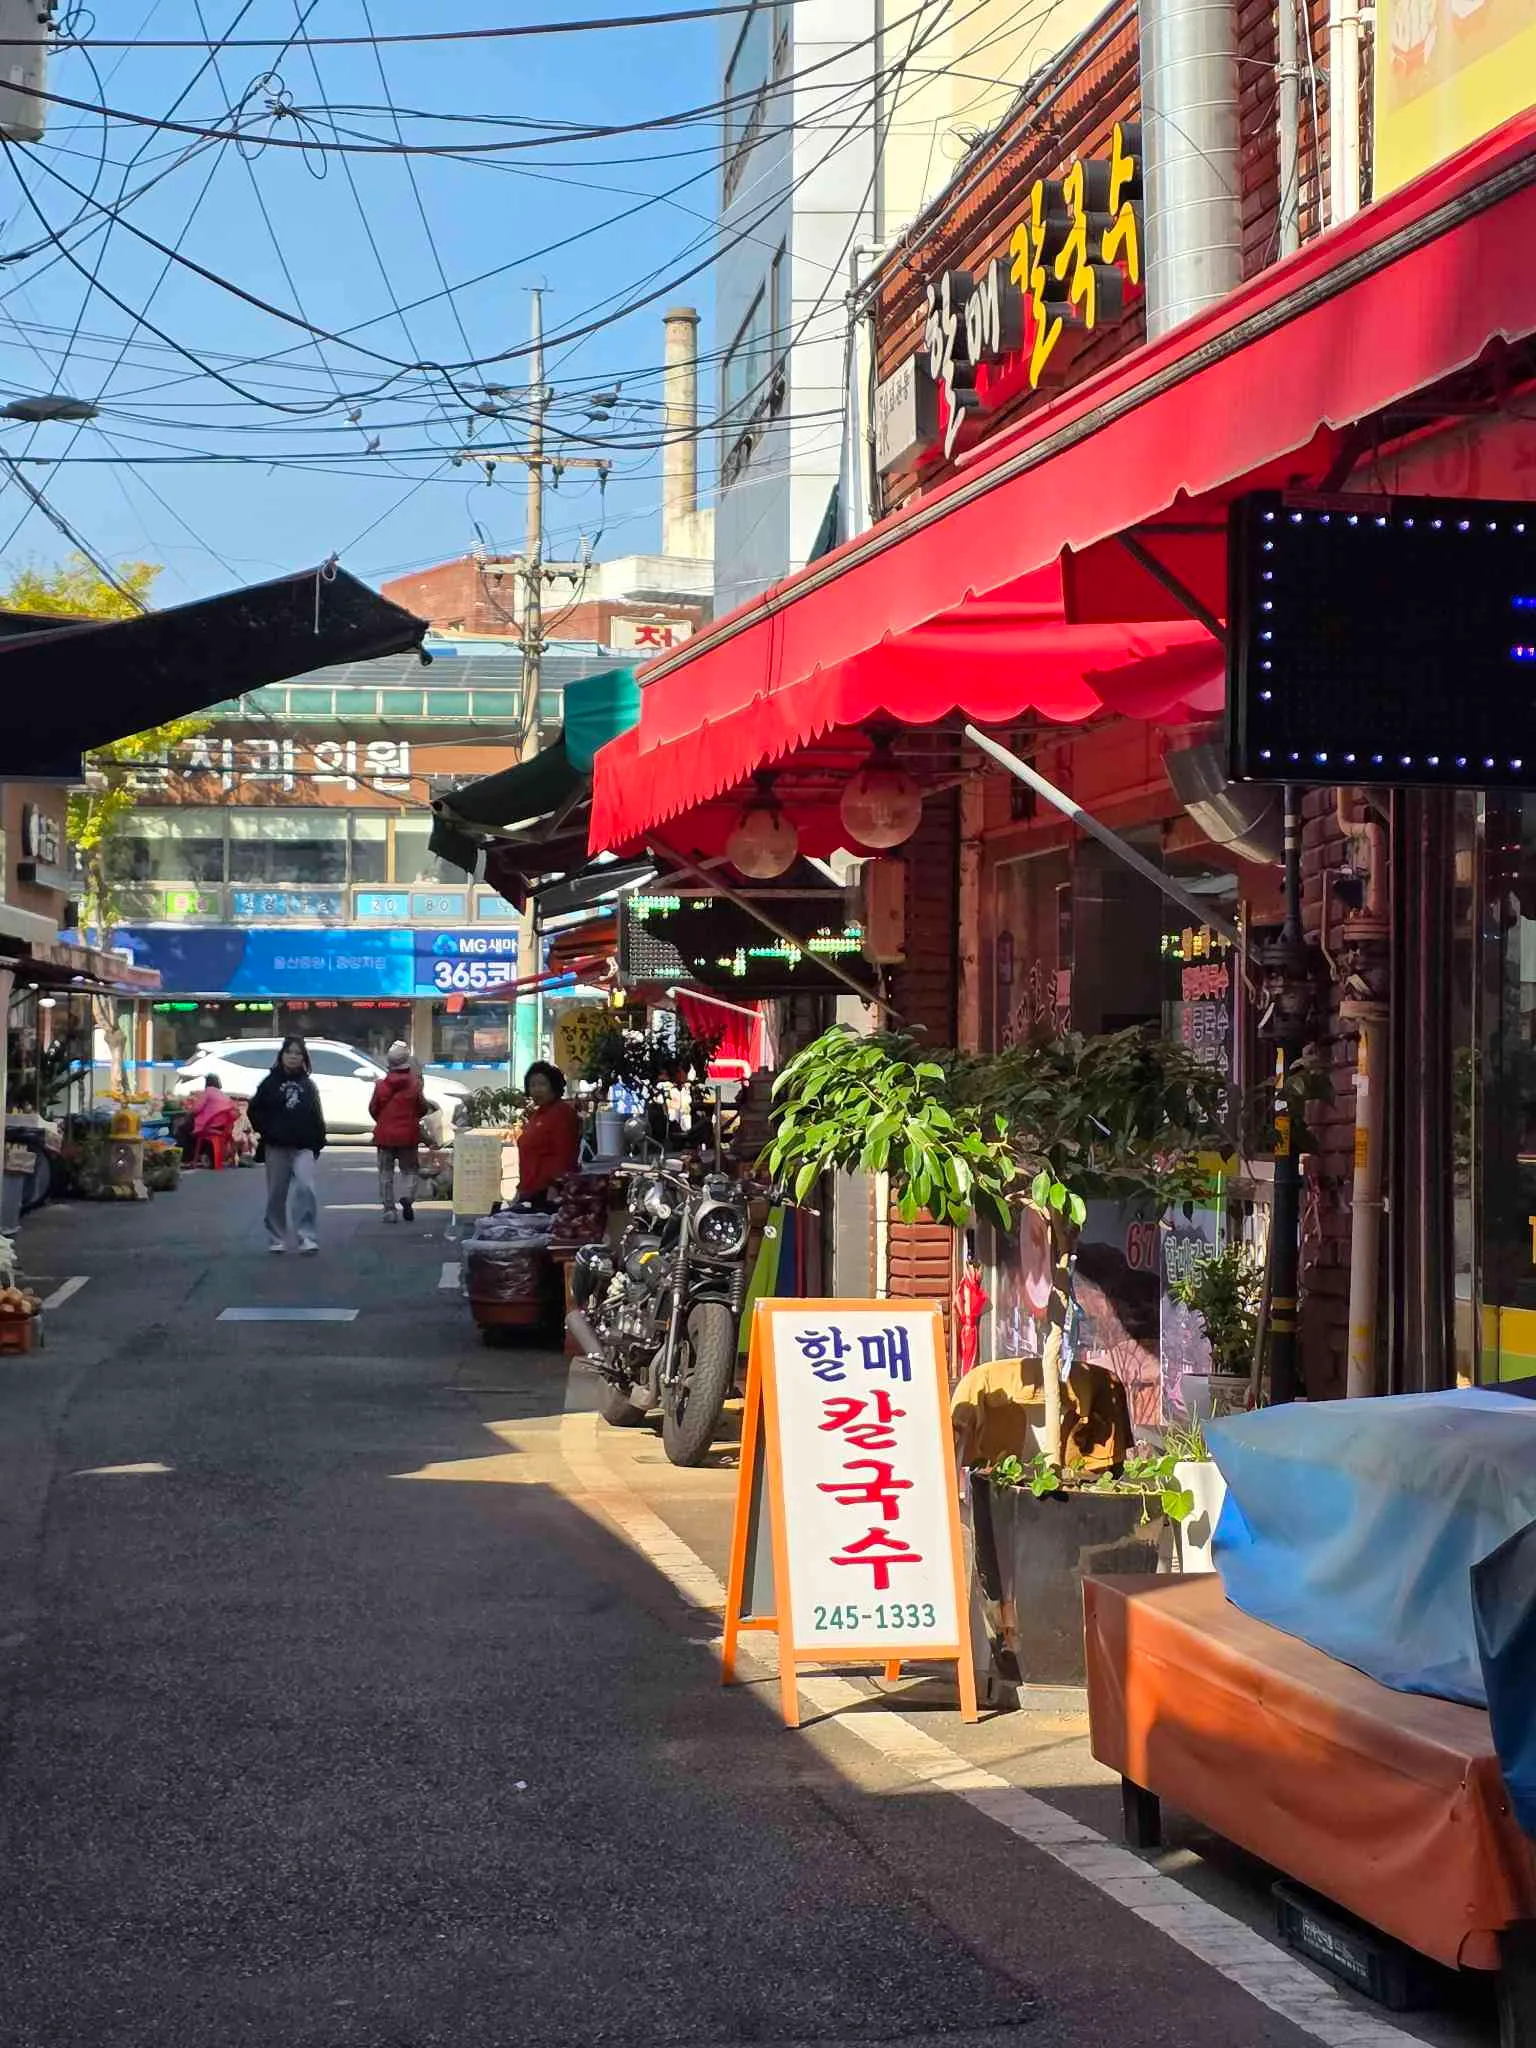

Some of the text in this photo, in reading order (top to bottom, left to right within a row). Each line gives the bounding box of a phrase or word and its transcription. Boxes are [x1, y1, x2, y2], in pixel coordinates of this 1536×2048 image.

[923, 120, 1140, 461] 할매 칼국수
[795, 1325, 912, 1383] 할매
[816, 1389, 923, 1590] 칼국수
[813, 1602, 937, 1632] 245-1333
